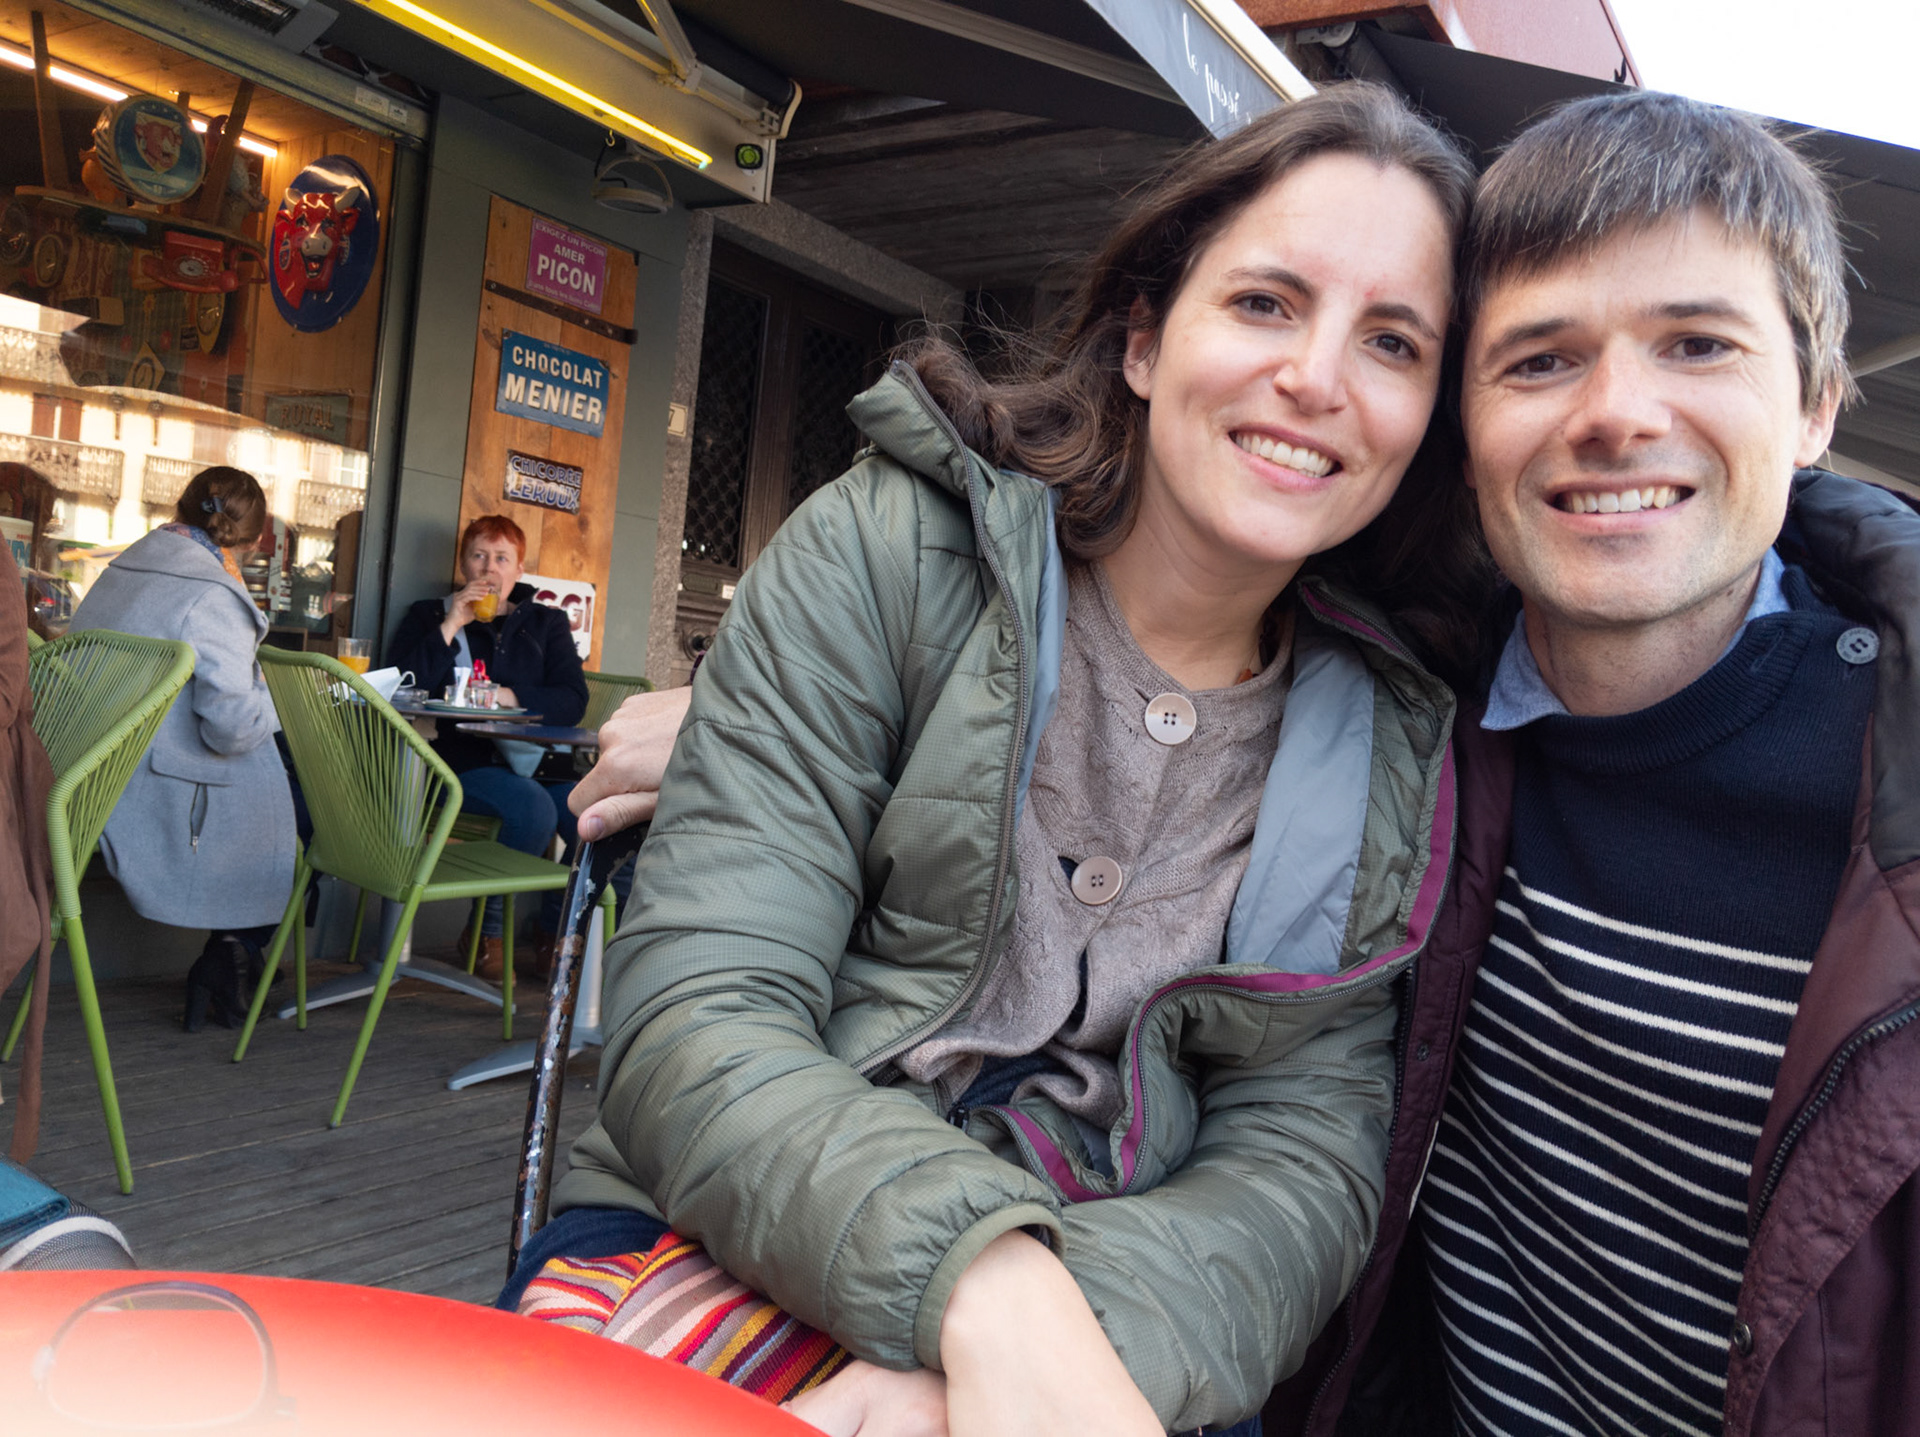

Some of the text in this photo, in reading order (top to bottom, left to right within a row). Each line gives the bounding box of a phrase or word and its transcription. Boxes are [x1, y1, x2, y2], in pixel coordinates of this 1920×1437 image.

[535, 222, 605, 257] EXIGEZ UN PICON
[554, 243, 586, 265] AMER
[536, 253, 596, 297] PICON
[512, 345, 603, 390] CHOCOLAT
[280, 404, 334, 429] ROYAL
[504, 372, 602, 425] MENIER
[509, 473, 580, 511] LEROUX
